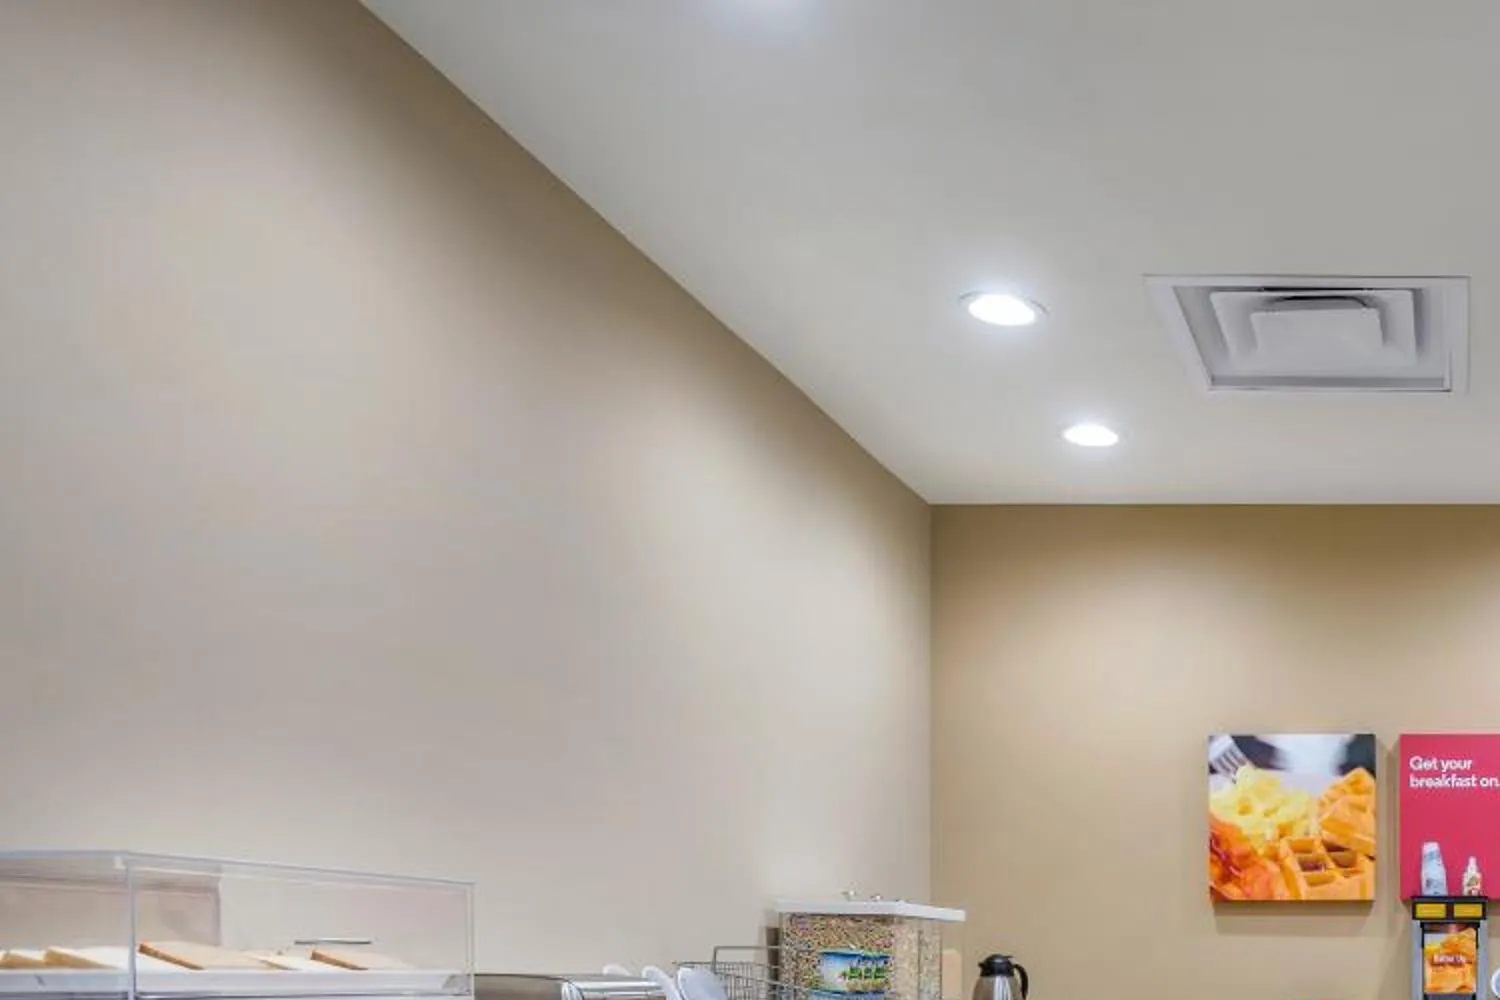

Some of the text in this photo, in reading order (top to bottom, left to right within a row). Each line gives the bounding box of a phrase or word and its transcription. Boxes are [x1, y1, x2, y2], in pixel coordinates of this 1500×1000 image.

[1409, 755, 1473, 773] Get your
[1409, 773, 1478, 788] breakfast
